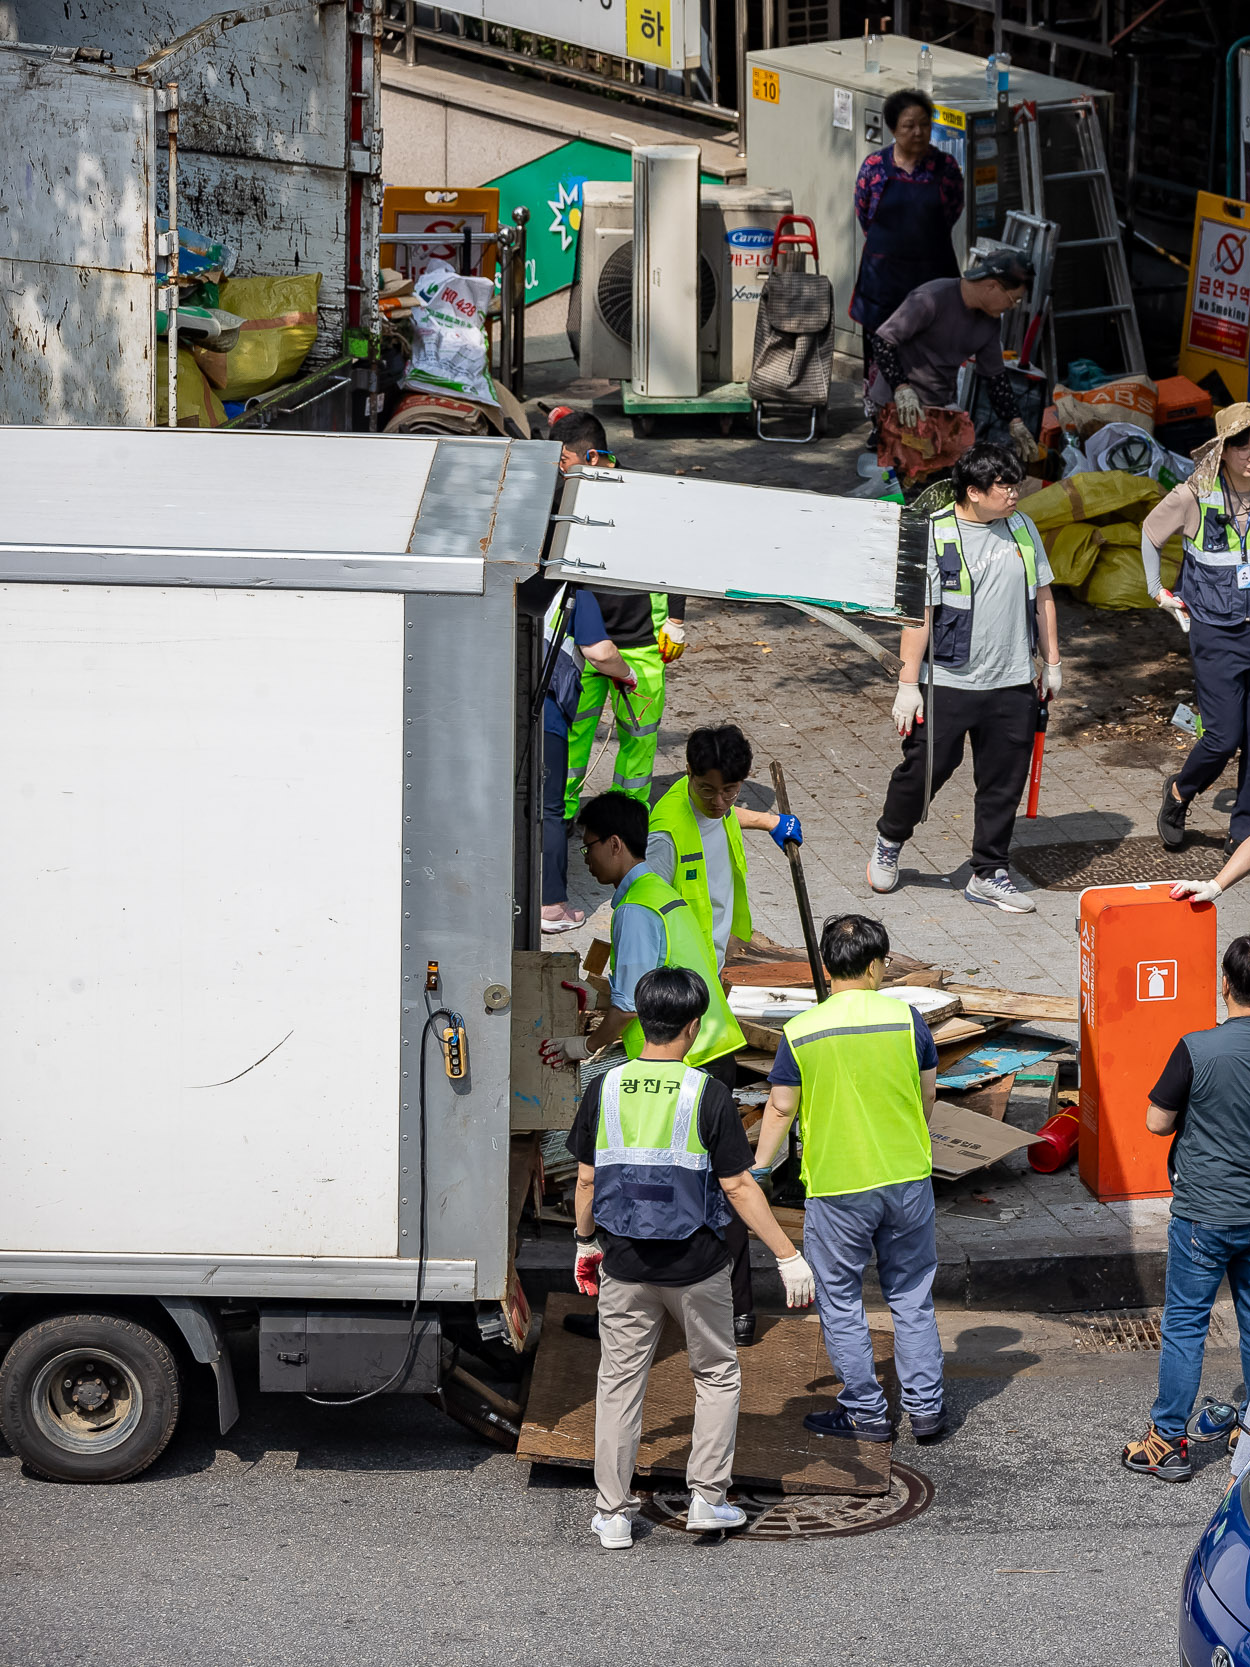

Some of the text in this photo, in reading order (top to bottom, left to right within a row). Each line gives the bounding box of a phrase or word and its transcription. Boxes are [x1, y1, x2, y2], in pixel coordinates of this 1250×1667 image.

[640, 9, 665, 47] 하
[762, 82, 777, 100] 10
[731, 231, 774, 244] Carrier
[1199, 274, 1250, 307] 금연구역
[456, 298, 477, 317] 428
[1198, 299, 1246, 323] No Smoking
[1091, 389, 1154, 414] ABS
[1081, 920, 1092, 1025] 소화기
[620, 1078, 681, 1095] 광진구
